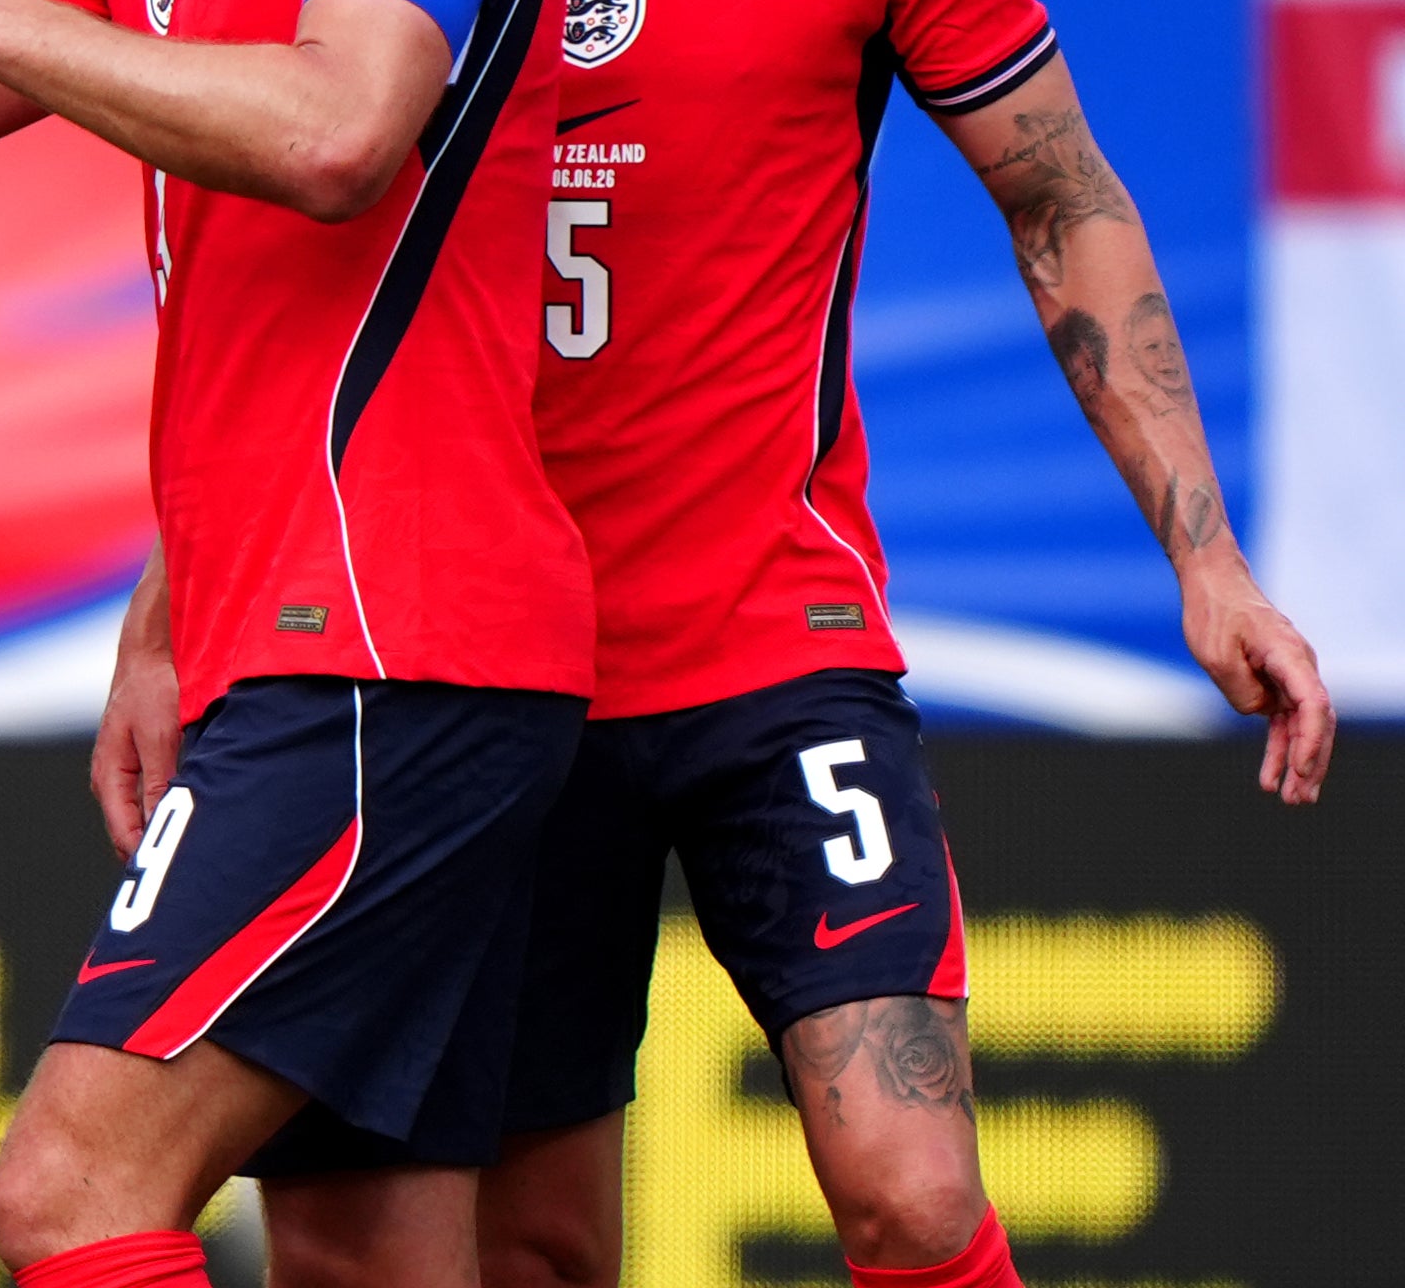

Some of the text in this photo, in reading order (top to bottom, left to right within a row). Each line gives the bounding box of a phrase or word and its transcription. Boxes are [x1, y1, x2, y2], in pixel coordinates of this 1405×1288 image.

[552, 168, 615, 188] 06.06.26
[565, 143, 646, 164] ZEALAND
[546, 200, 612, 359] 5
[110, 786, 195, 933] 9
[799, 739, 894, 885] 5
